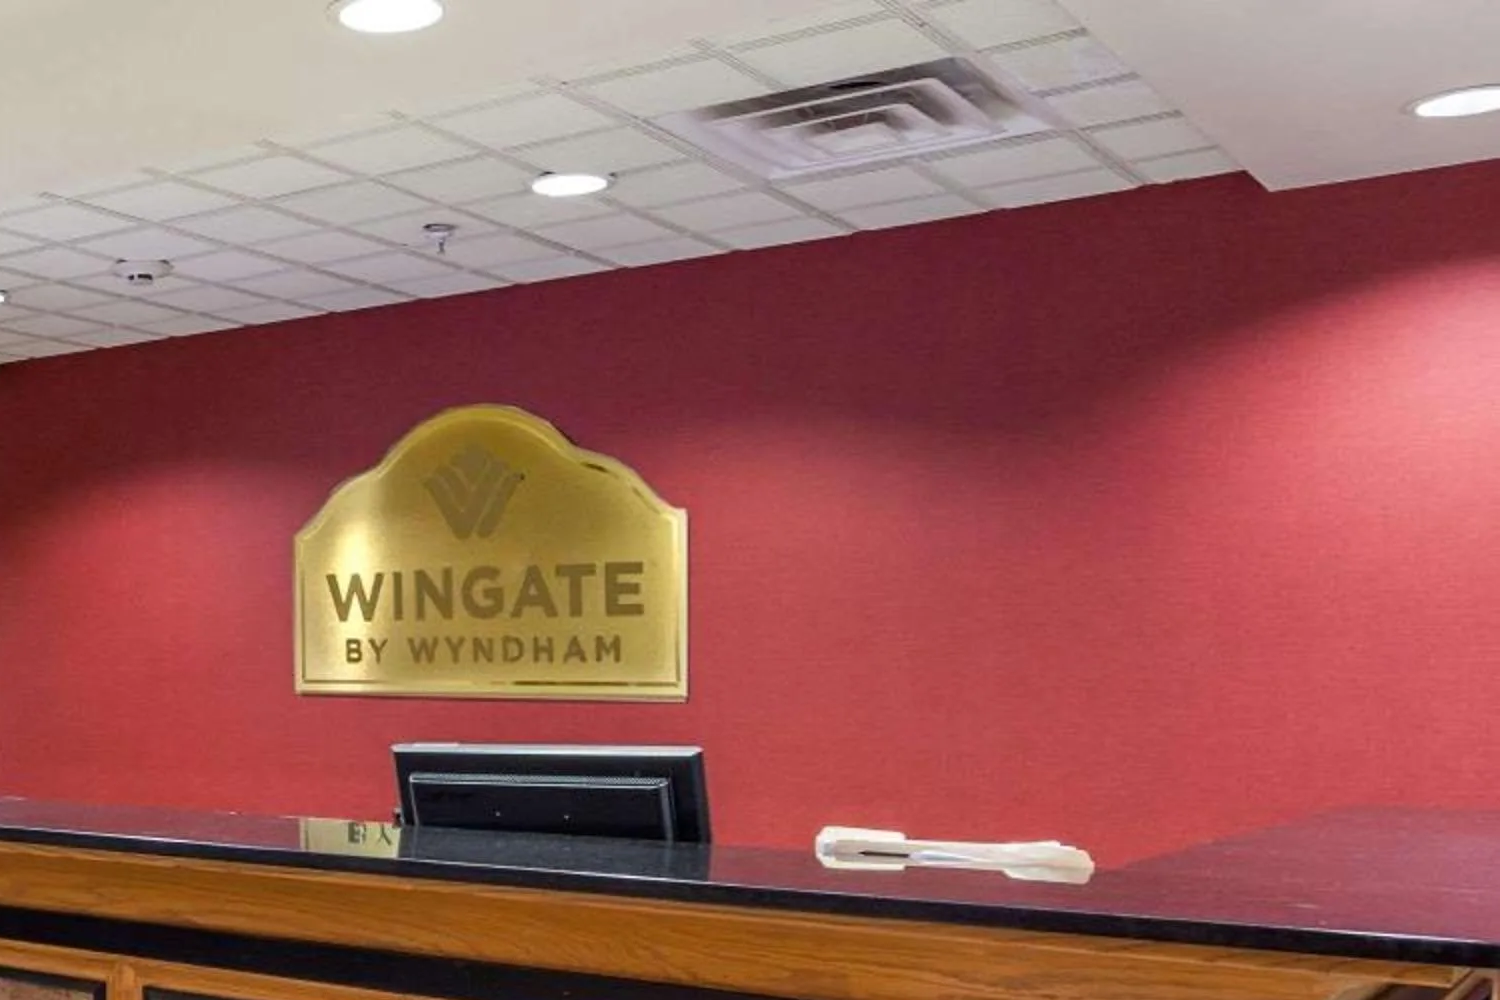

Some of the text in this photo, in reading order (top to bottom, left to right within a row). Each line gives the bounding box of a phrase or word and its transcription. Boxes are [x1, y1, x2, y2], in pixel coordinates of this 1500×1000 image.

[326, 561, 645, 623] WINGATE
[346, 635, 621, 664] BY WYNDHAM
